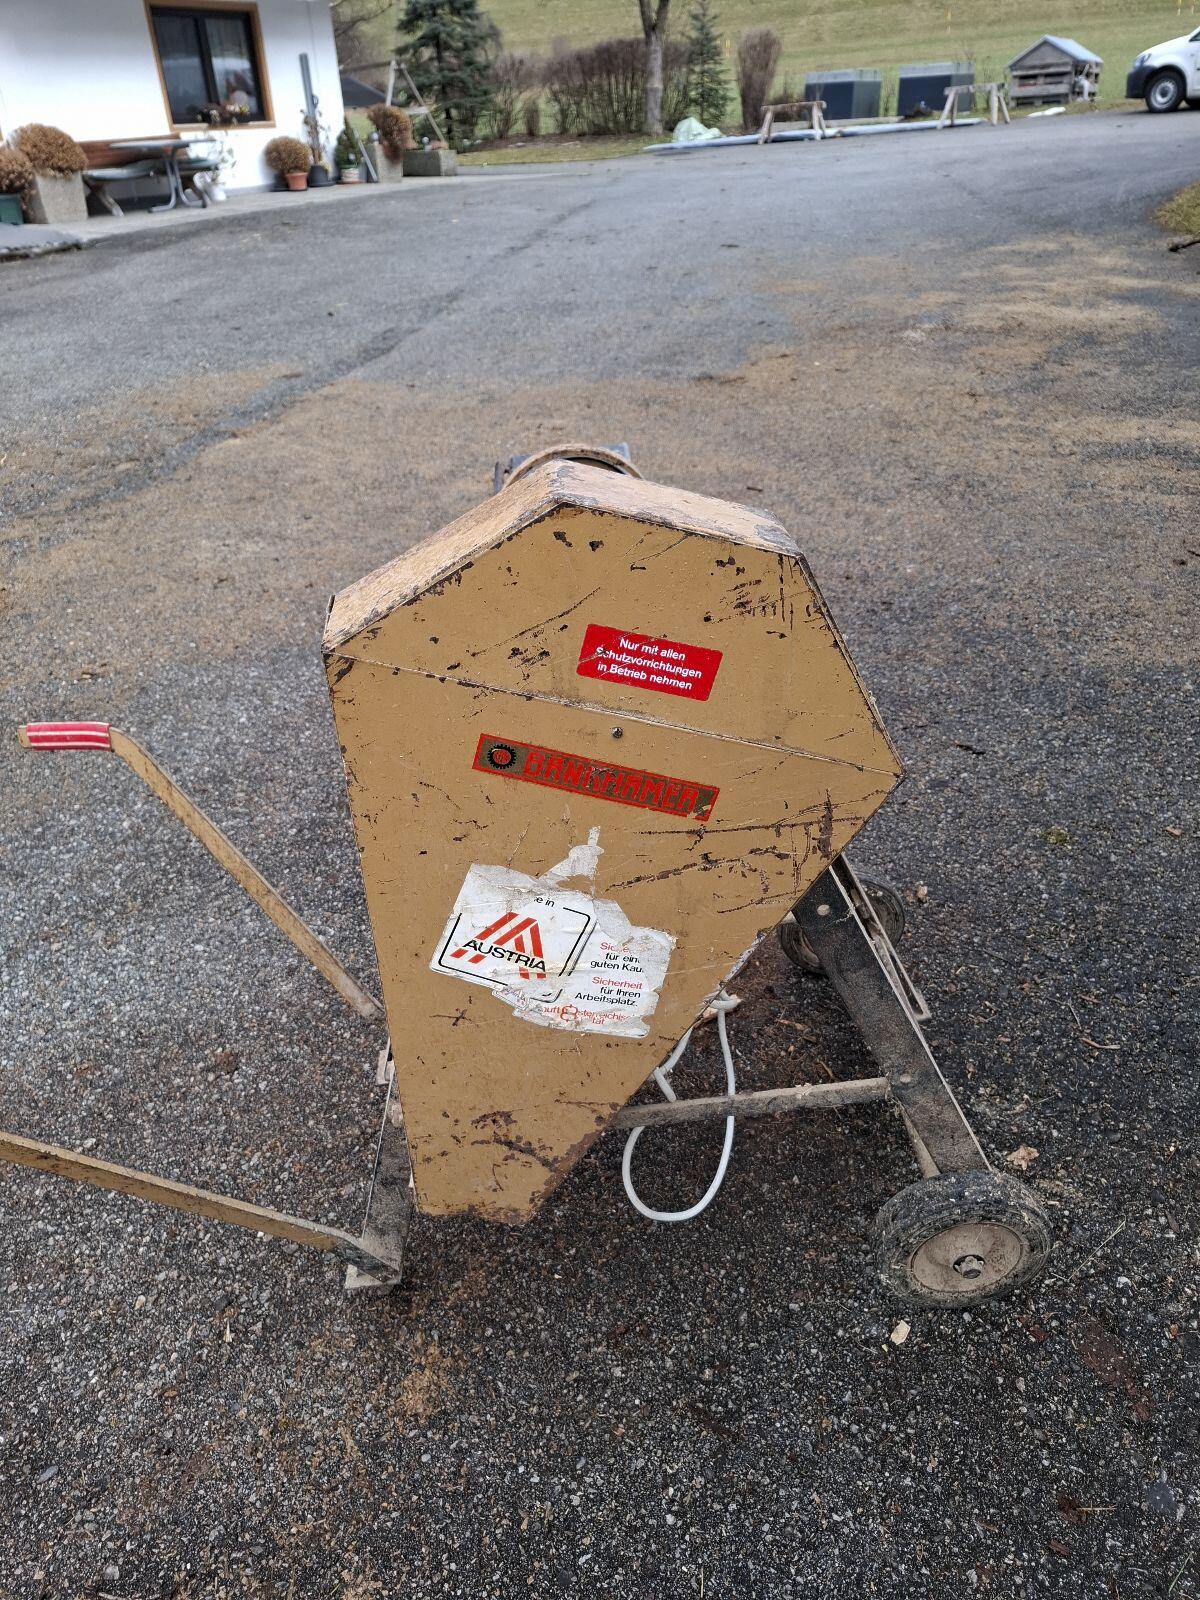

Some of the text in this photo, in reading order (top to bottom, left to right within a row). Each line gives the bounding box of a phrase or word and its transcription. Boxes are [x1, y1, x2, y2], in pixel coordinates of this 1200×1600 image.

[619, 637, 686, 661] Nur mit allen
[596, 646, 702, 679] Schutzvorrichtungen
[597, 661, 692, 690] in Betrieb nehmen
[545, 897, 555, 907] in
[462, 939, 546, 973] AUSTRIA
[605, 952, 641, 964] für ein
[590, 960, 644, 974] guten Kau
[592, 976, 643, 990] Sicherheit
[575, 992, 638, 1007] Arbeitsplatz.
[600, 986, 641, 999] für Ihren
